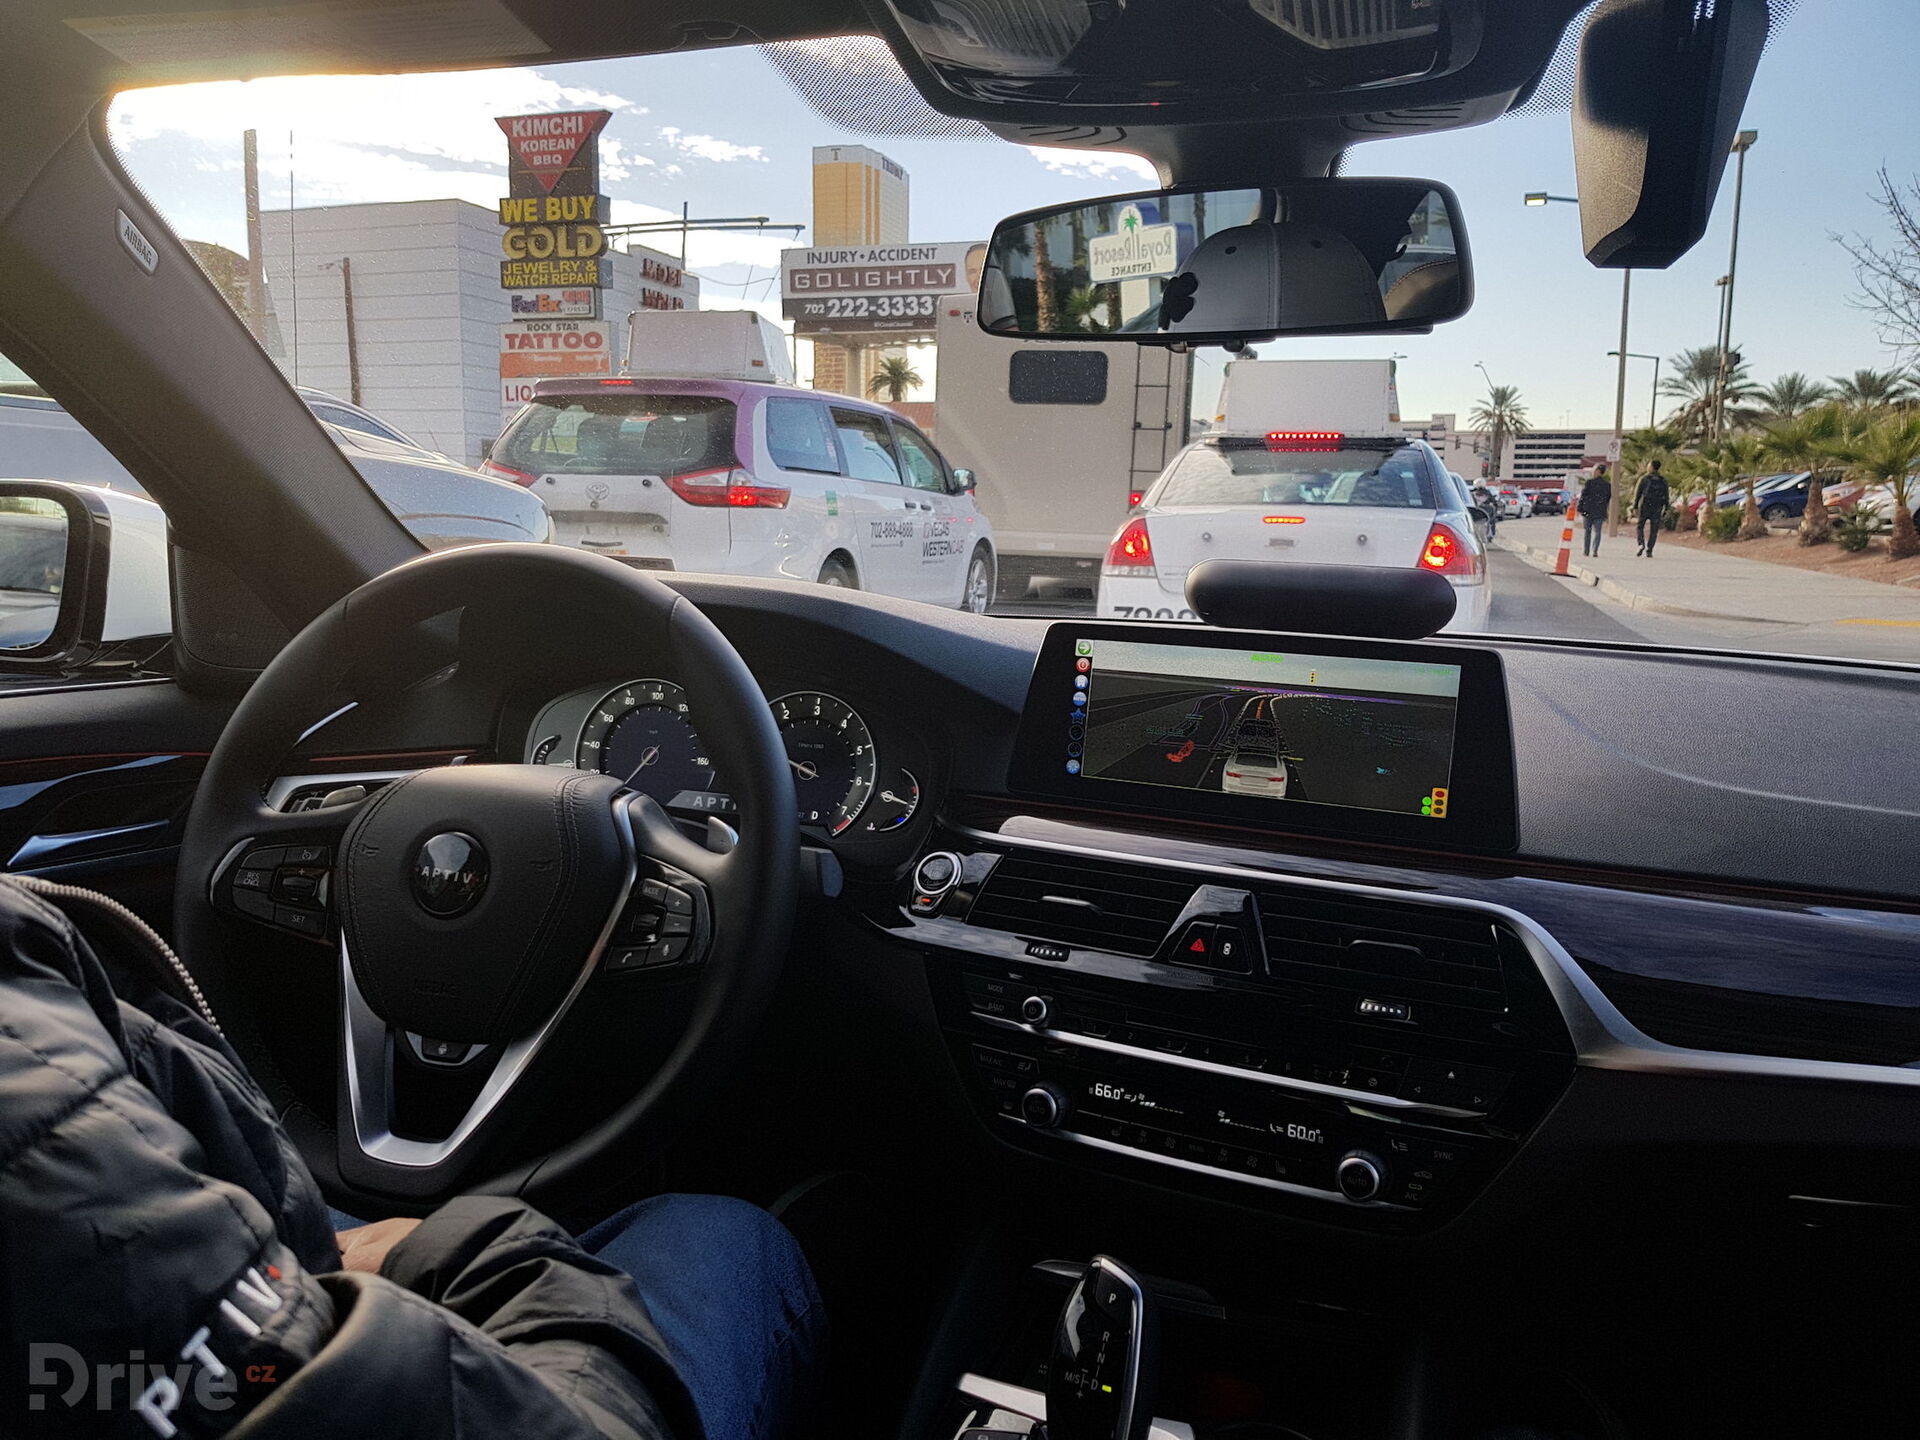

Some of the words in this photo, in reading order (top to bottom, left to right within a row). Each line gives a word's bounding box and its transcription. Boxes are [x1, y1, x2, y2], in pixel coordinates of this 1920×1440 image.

[512, 116, 583, 137] KIMCHI
[520, 138, 576, 153] KOREAN
[533, 154, 562, 165] BBQ
[501, 198, 538, 223] WE
[546, 195, 595, 221] BUY
[124, 226, 153, 266] AIRBAG
[502, 226, 602, 260] GOLD
[806, 250, 857, 265] INJURY
[867, 247, 938, 263] ACCIDENT
[503, 261, 580, 275] JEWELRY
[585, 260, 597, 272] &
[503, 274, 548, 288] WATCH
[551, 273, 598, 286] REPAIR
[794, 268, 953, 289] GOLIGHTLY
[804, 304, 825, 314] 702
[827, 296, 934, 318] 222-3333
[526, 323, 552, 332] ROCK
[556, 323, 580, 332] STAR
[504, 332, 603, 349] TATTOO
[652, 691, 664, 700] 100
[625, 697, 635, 706] 80
[783, 709, 790, 720] 2
[814, 706, 821, 716] 3
[604, 714, 614, 723] 60
[841, 719, 848, 728] 4
[589, 740, 600, 749] 40
[856, 746, 863, 756] 5
[856, 776, 863, 786] 6
[811, 810, 819, 821] D
[841, 806, 848, 816] 7
[421, 865, 473, 884] APTIV
[1108, 1292, 1117, 1304] P
[1102, 1331, 1110, 1342] R
[1096, 1352, 1106, 1364] N
